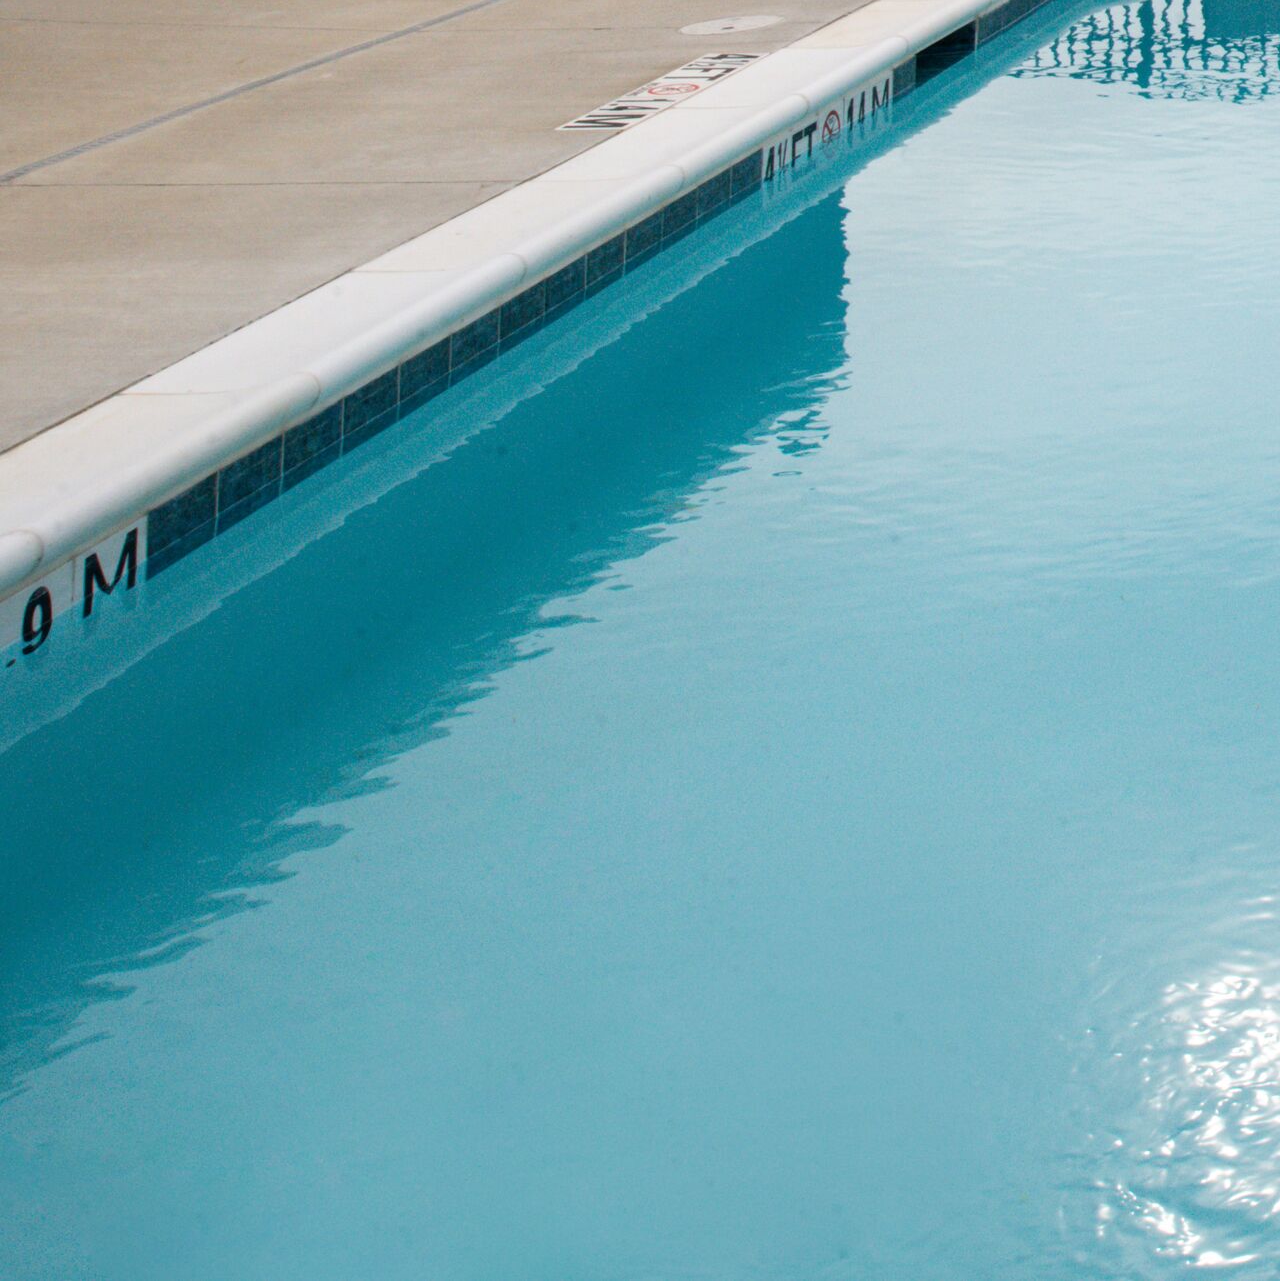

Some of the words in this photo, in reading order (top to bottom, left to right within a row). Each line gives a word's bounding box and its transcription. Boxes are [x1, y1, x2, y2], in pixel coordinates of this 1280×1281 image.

[664, 67, 737, 82] FT
[562, 114, 647, 129] M
[791, 121, 818, 168] FT
[872, 78, 890, 118] M
[82, 526, 139, 620] M
